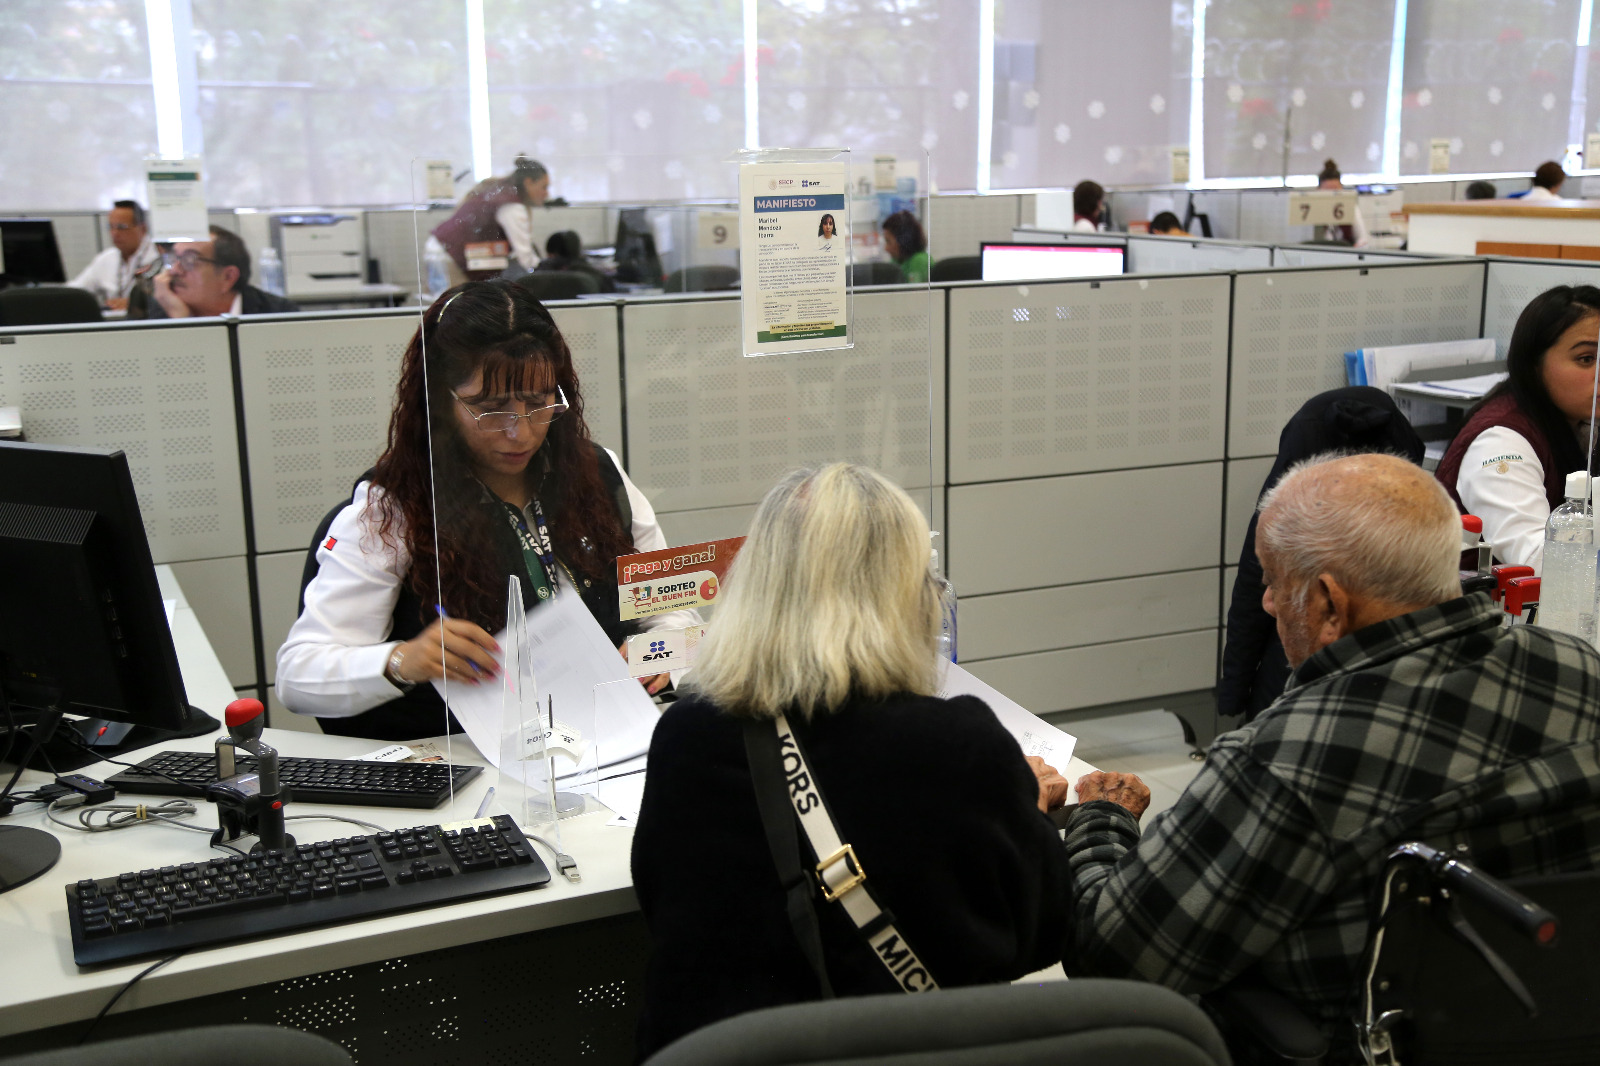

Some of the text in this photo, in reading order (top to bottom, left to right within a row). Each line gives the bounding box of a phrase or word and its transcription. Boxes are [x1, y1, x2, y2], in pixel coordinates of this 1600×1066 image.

[756, 198, 816, 209] MANIFIESTO
[1300, 202, 1344, 221] 7 6
[713, 225, 727, 244] 9
[1481, 454, 1523, 466] HACIENDA
[538, 525, 552, 553] SAT
[623, 544, 716, 583] ¡Paga y gana!
[651, 596, 661, 604] EL
[662, 591, 683, 602] BUEN
[684, 589, 697, 598] FIN
[657, 580, 696, 595] SORTEO
[642, 650, 673, 662] SAT
[778, 733, 820, 815] KORS
[876, 934, 936, 994] MIC
